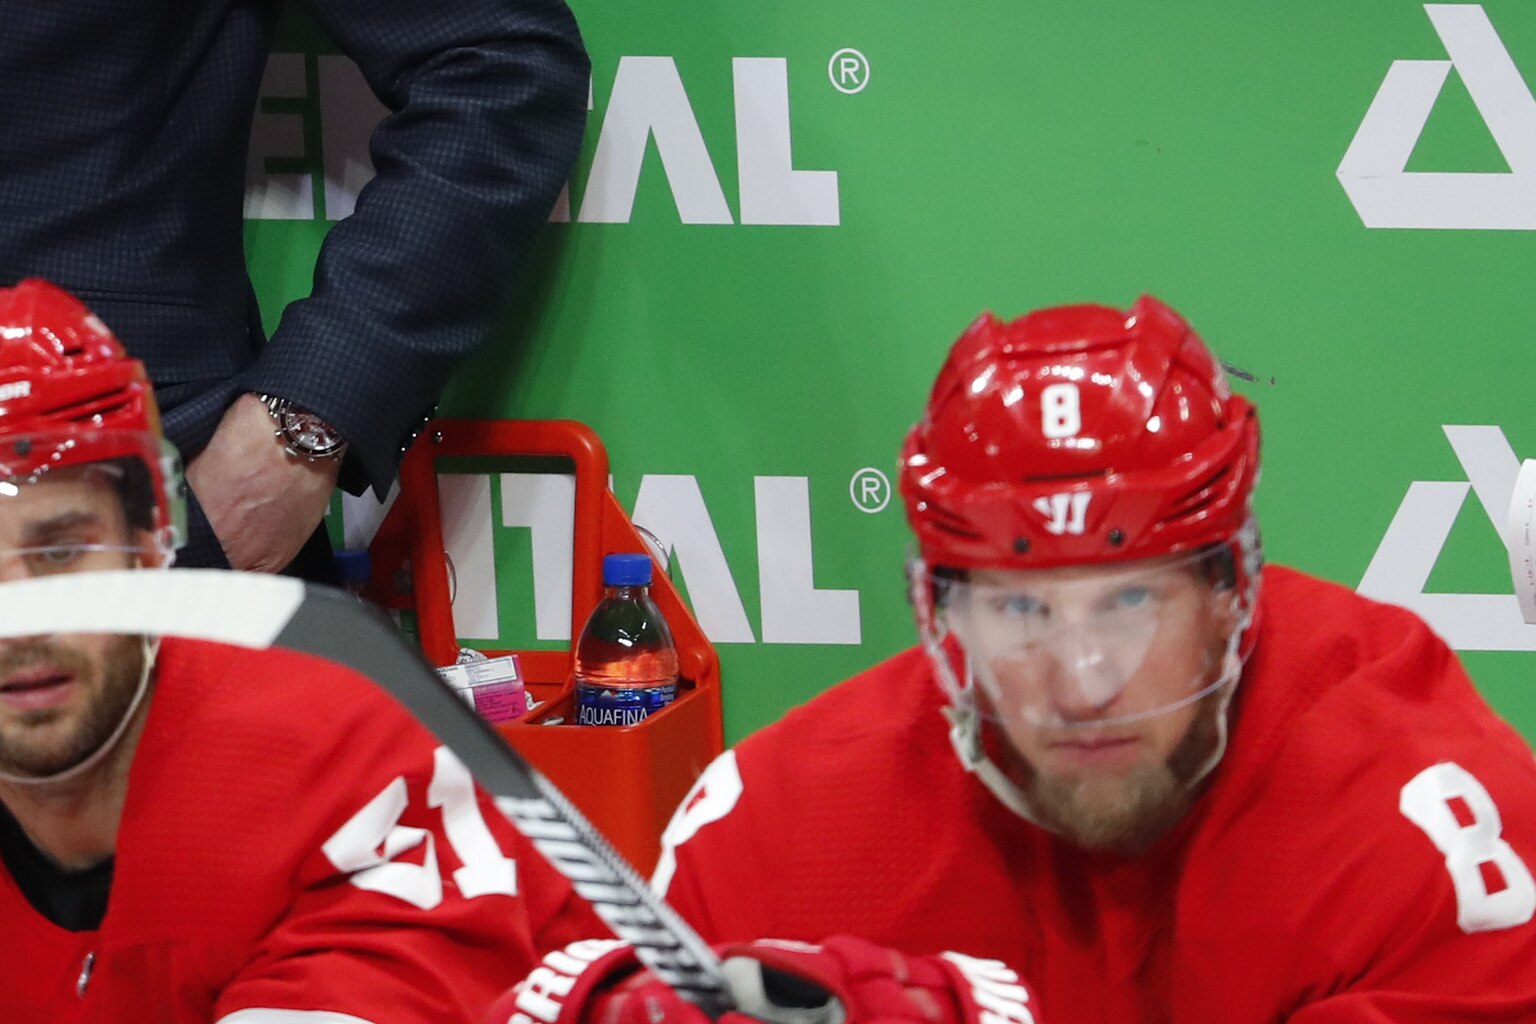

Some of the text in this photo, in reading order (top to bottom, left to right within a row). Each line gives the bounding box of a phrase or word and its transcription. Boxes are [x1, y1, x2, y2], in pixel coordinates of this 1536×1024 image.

[1041, 383, 1081, 439] 8
[579, 704, 648, 727] AQUAFINA
[1400, 761, 1536, 933] 8
